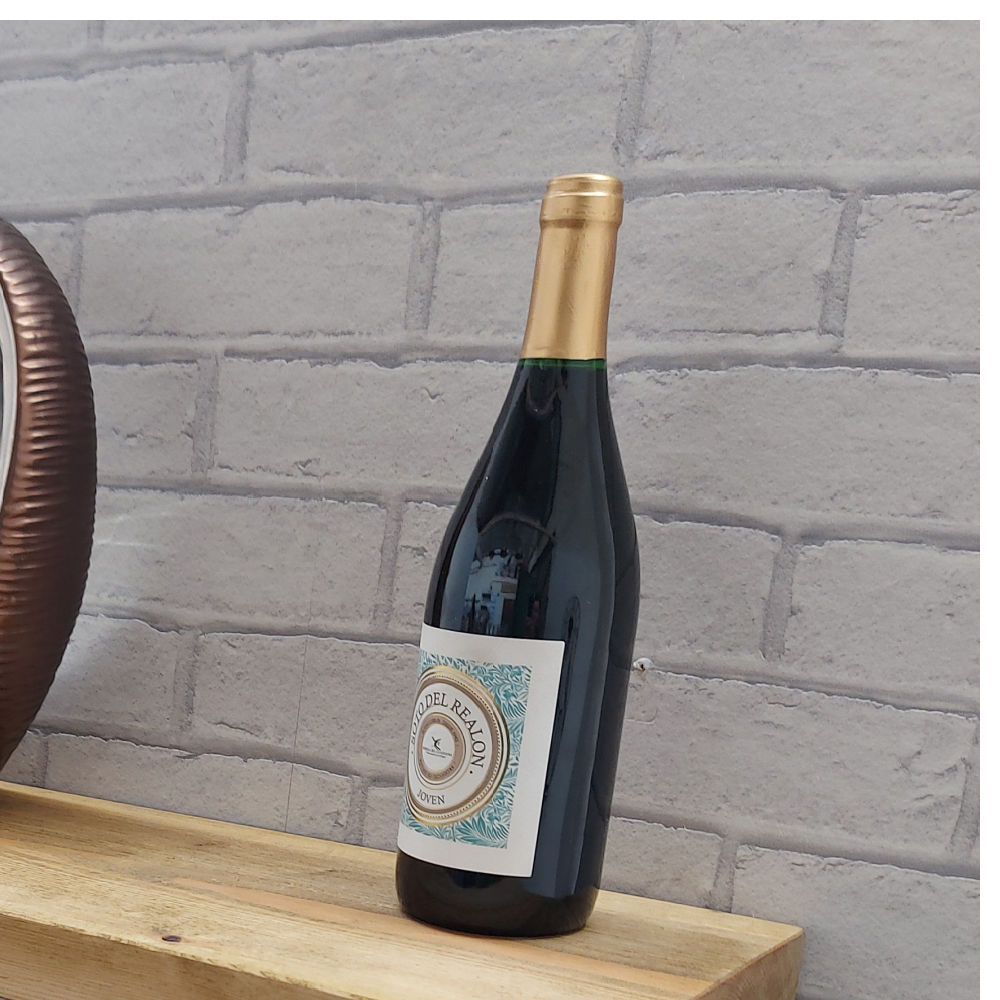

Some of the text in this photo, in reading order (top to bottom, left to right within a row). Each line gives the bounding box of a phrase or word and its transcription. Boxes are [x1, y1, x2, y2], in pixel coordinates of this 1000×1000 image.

[425, 691, 449, 708] DEL
[450, 698, 486, 768] REALON
[416, 788, 446, 805] JOVEN
